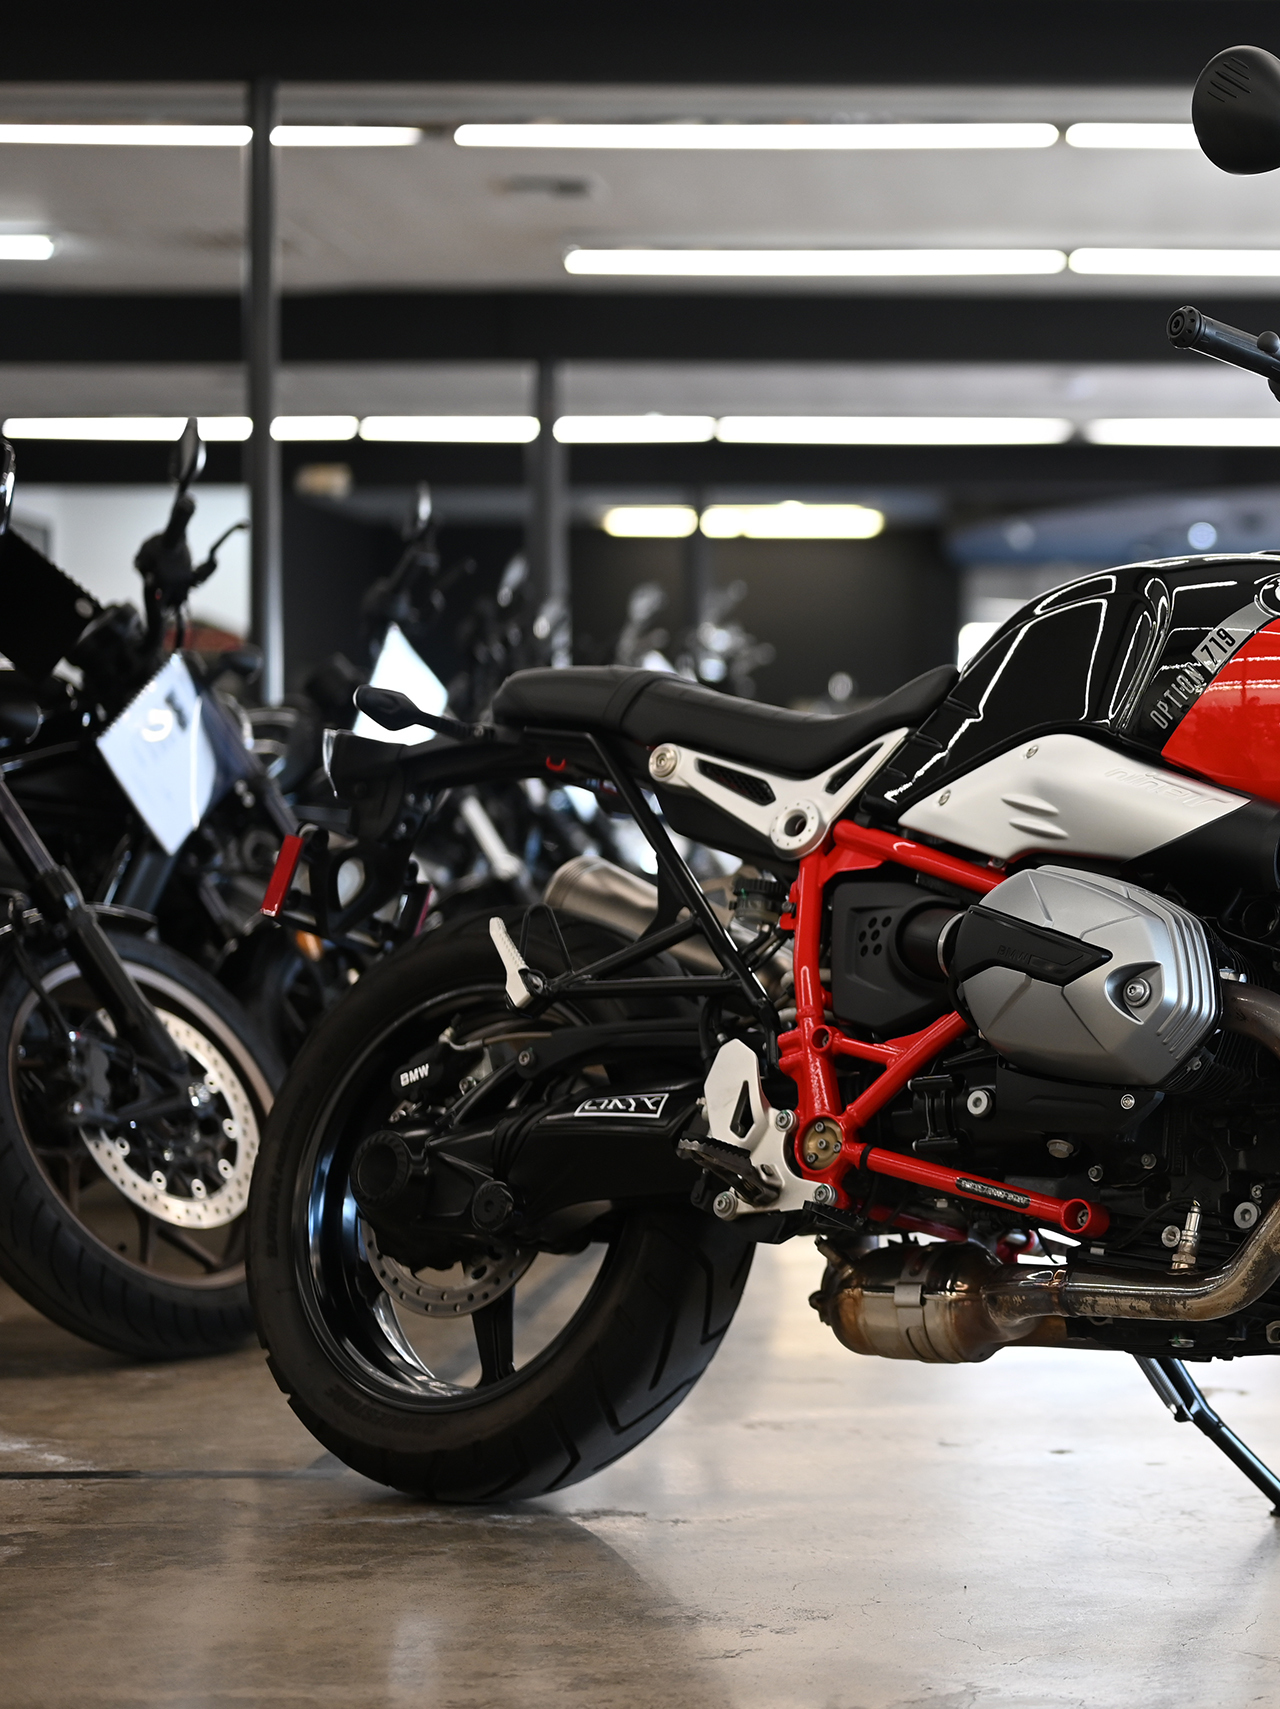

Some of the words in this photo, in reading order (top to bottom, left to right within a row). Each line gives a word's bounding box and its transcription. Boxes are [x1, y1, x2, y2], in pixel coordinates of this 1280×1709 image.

[1150, 662, 1207, 729] OPTION
[1200, 627, 1236, 667] 719
[997, 944, 1030, 964] BMW
[400, 1063, 430, 1087] BMW
